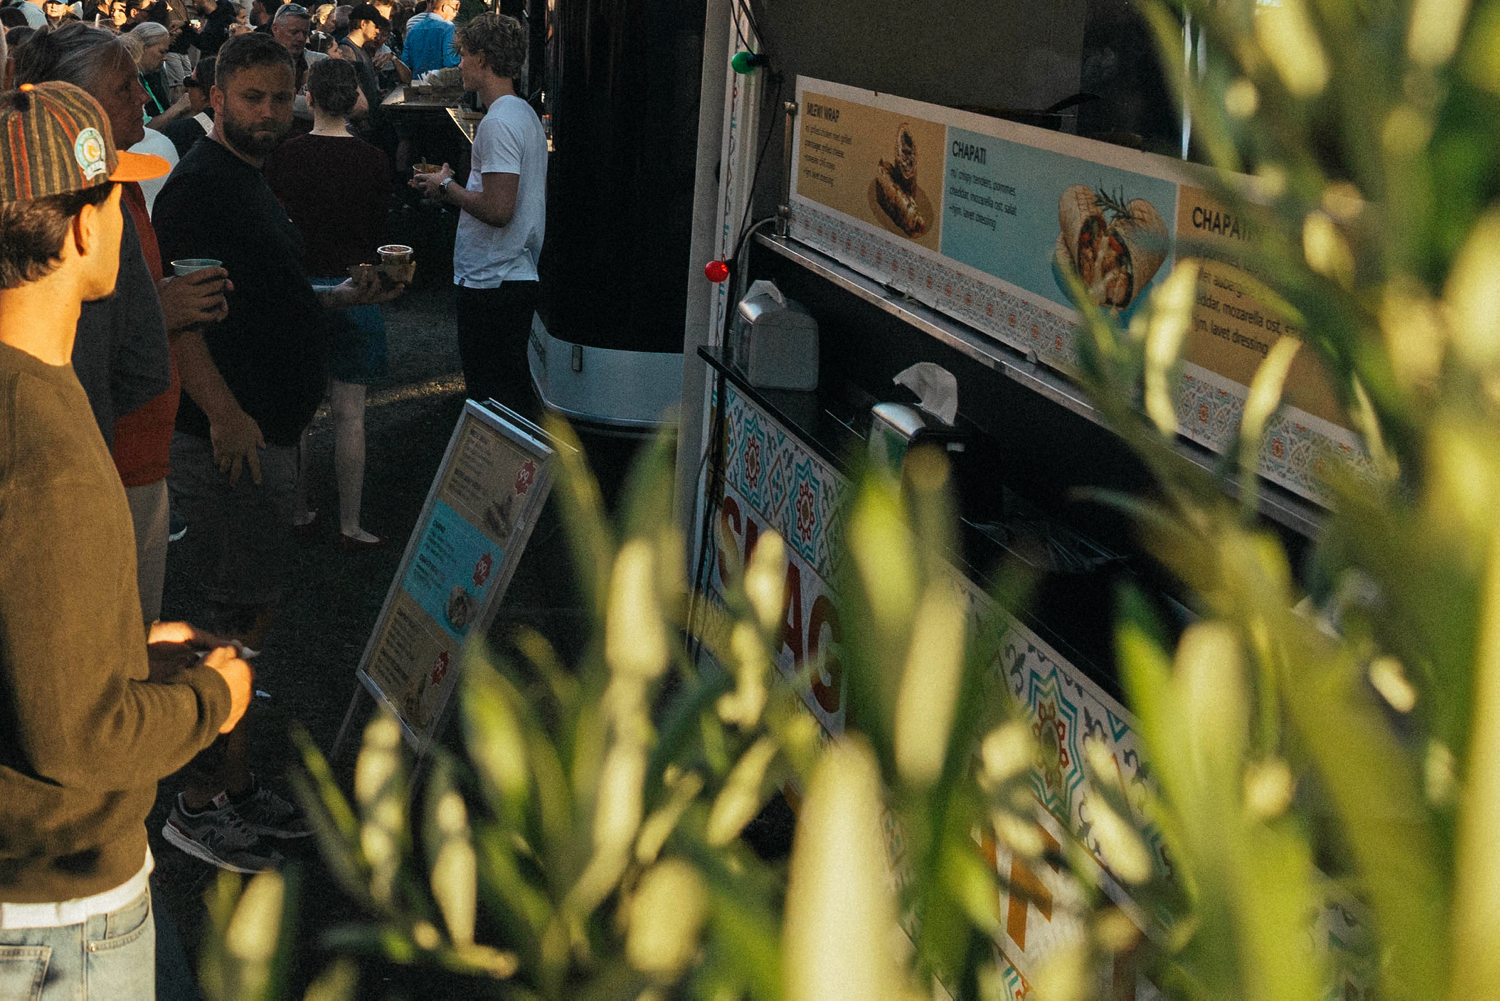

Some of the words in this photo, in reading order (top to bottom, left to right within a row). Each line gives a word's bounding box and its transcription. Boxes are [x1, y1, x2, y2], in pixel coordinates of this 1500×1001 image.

[952, 140, 986, 165] CHAPATI
[1192, 206, 1251, 241] CHAPA
[1223, 301, 1264, 327] mozarella
[1211, 319, 1231, 341] lavet
[1232, 326, 1270, 359] dressing
